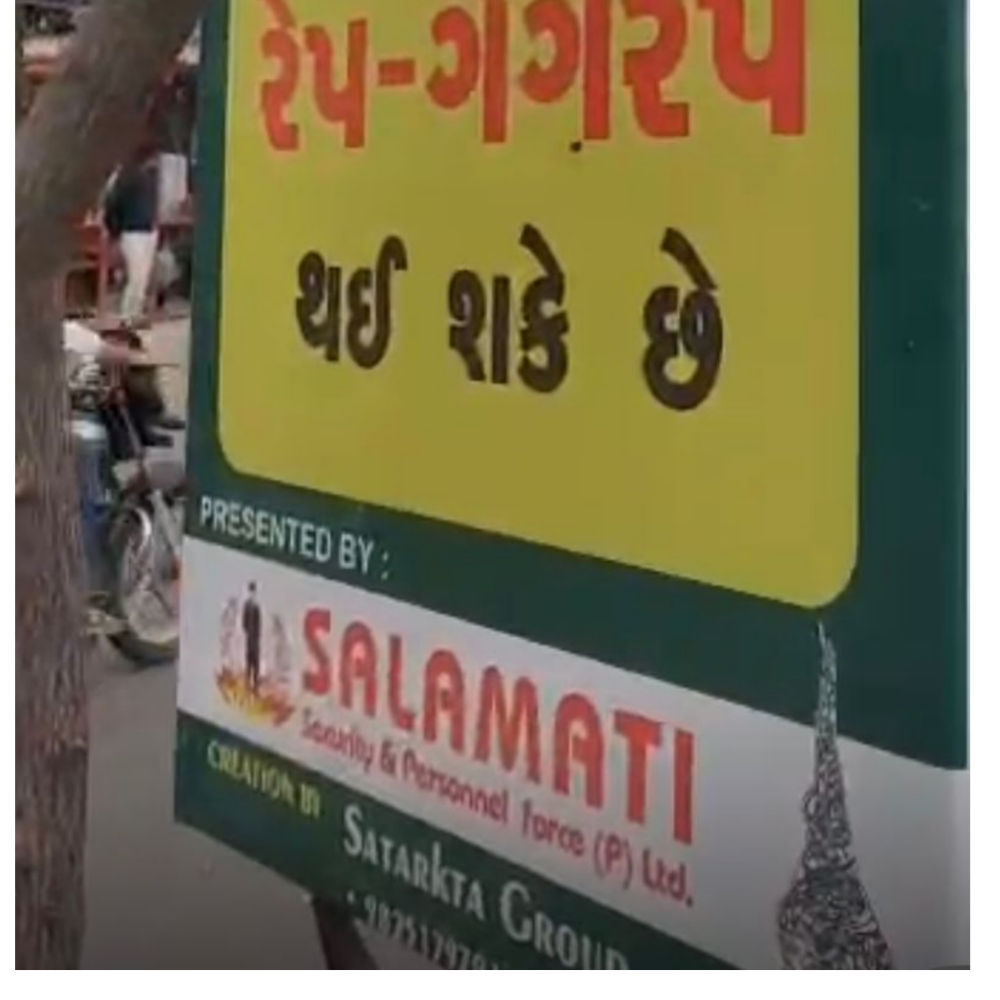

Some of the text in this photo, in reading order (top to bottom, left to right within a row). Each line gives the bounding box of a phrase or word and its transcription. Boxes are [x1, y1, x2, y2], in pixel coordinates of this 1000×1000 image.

[295, 222, 724, 411] થઈ શકે છે
[201, 496, 331, 564] PRESENTED
[339, 533, 375, 575] BY
[302, 608, 694, 846] SALAMATI
[402, 747, 510, 825] Personnel
[592, 828, 634, 891] (P)
